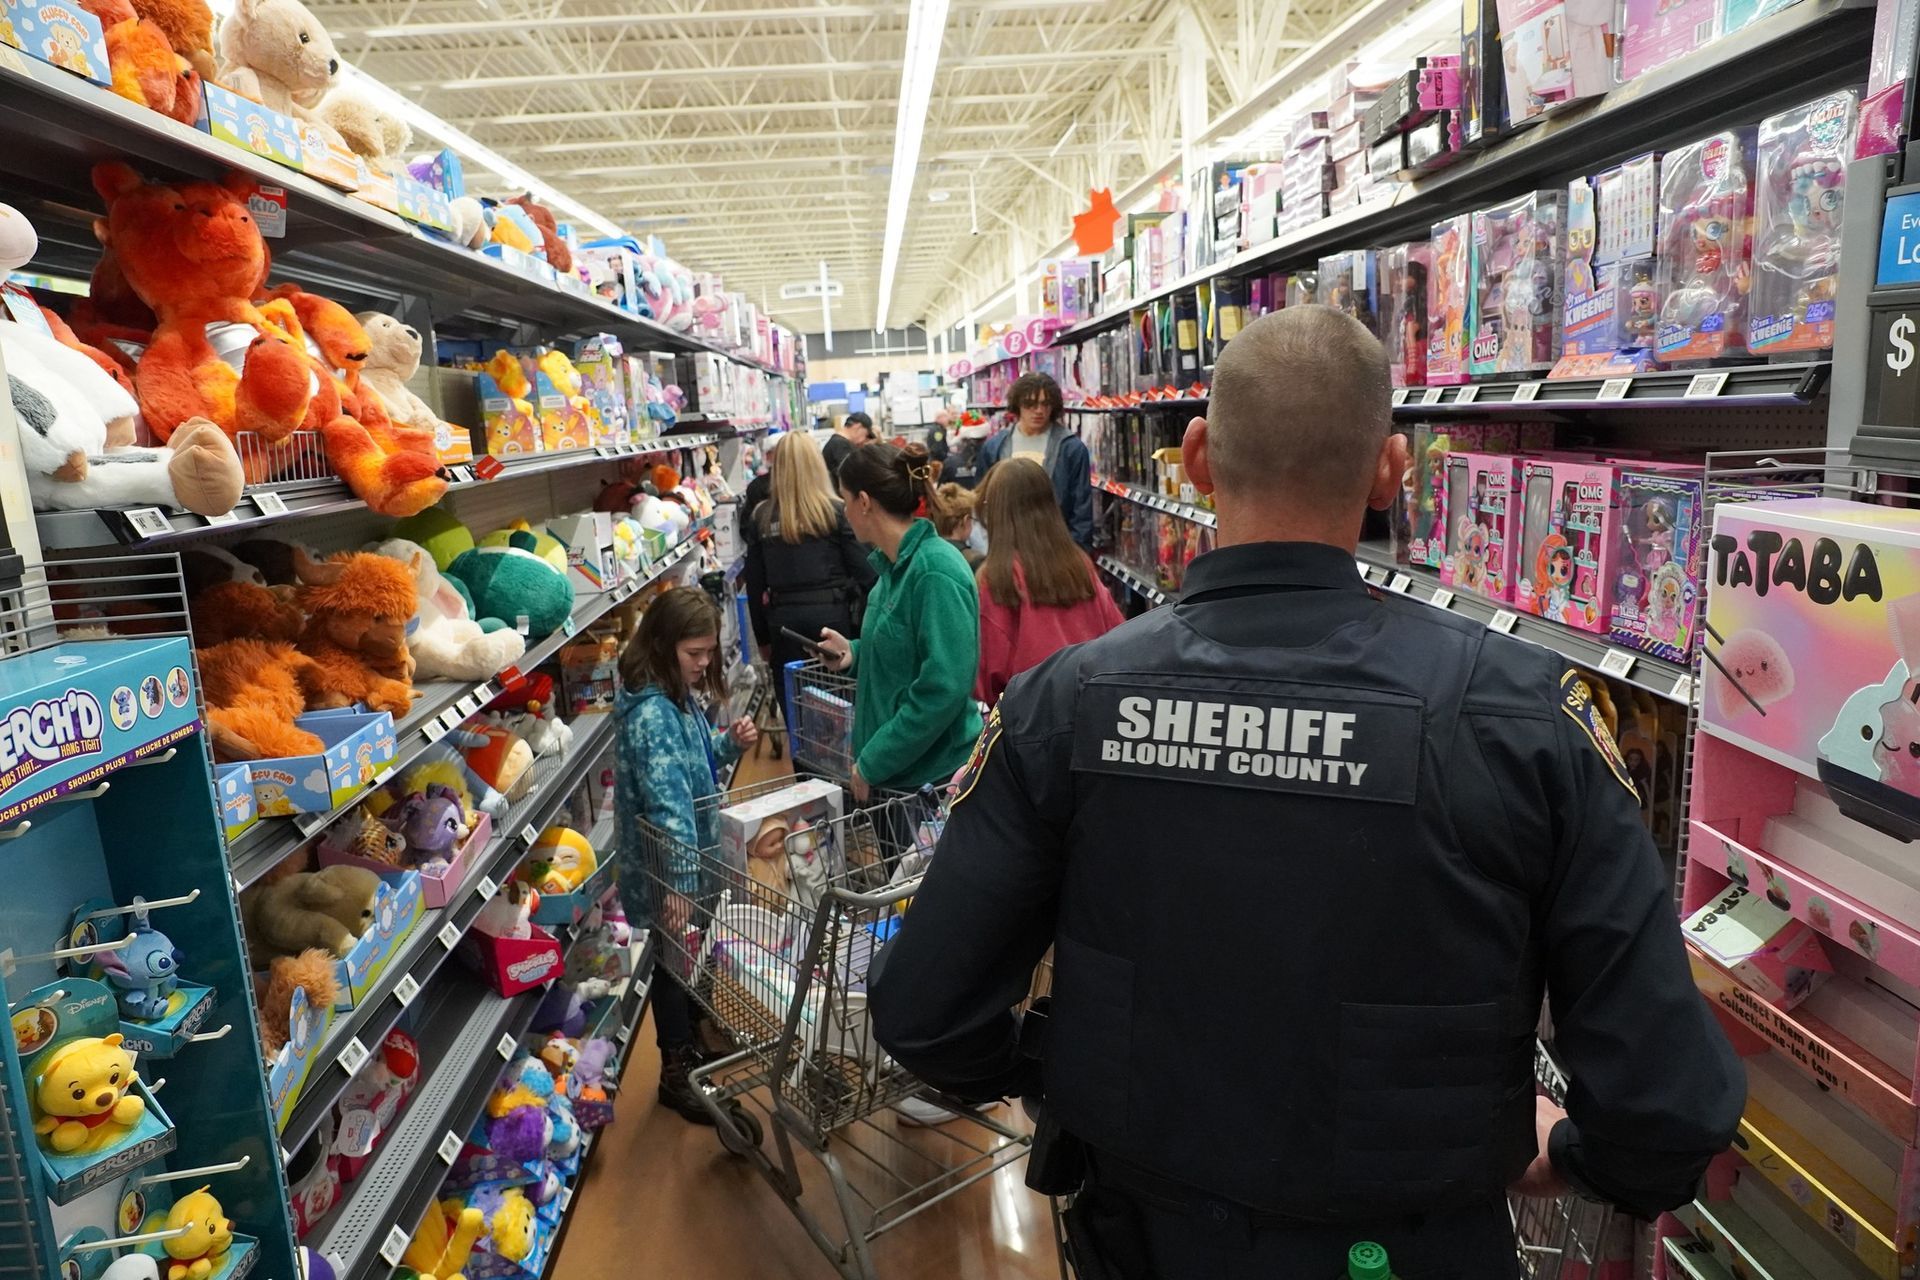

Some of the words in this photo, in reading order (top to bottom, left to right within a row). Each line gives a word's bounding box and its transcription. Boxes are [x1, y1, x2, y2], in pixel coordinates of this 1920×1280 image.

[1474, 338, 1498, 359] OMG
[1886, 313, 1916, 377] $
[1489, 473, 1505, 486] OMG
[1580, 485, 1604, 499] OMG
[61, 741, 80, 757] HANG
[81, 738, 100, 752] TIGHT
[1116, 695, 1357, 757] SHERIFF
[68, 767, 104, 790] SHOULDER
[105, 756, 127, 772] PLUSH
[135, 740, 161, 758] PELUCHE
[162, 736, 170, 746] DE
[273, 771, 295, 785] FAM
[1101, 739, 1222, 772] BLOUNT
[1228, 751, 1368, 786] COUNTY
[1719, 991, 1808, 1065] Collectionne-les
[1811, 1059, 1838, 1087] tous
[1732, 986, 1769, 1020] Collect
[1772, 1014, 1805, 1046] Them
[1808, 1040, 1830, 1064] All!
[82, 1138, 158, 1186] PERCH'D
